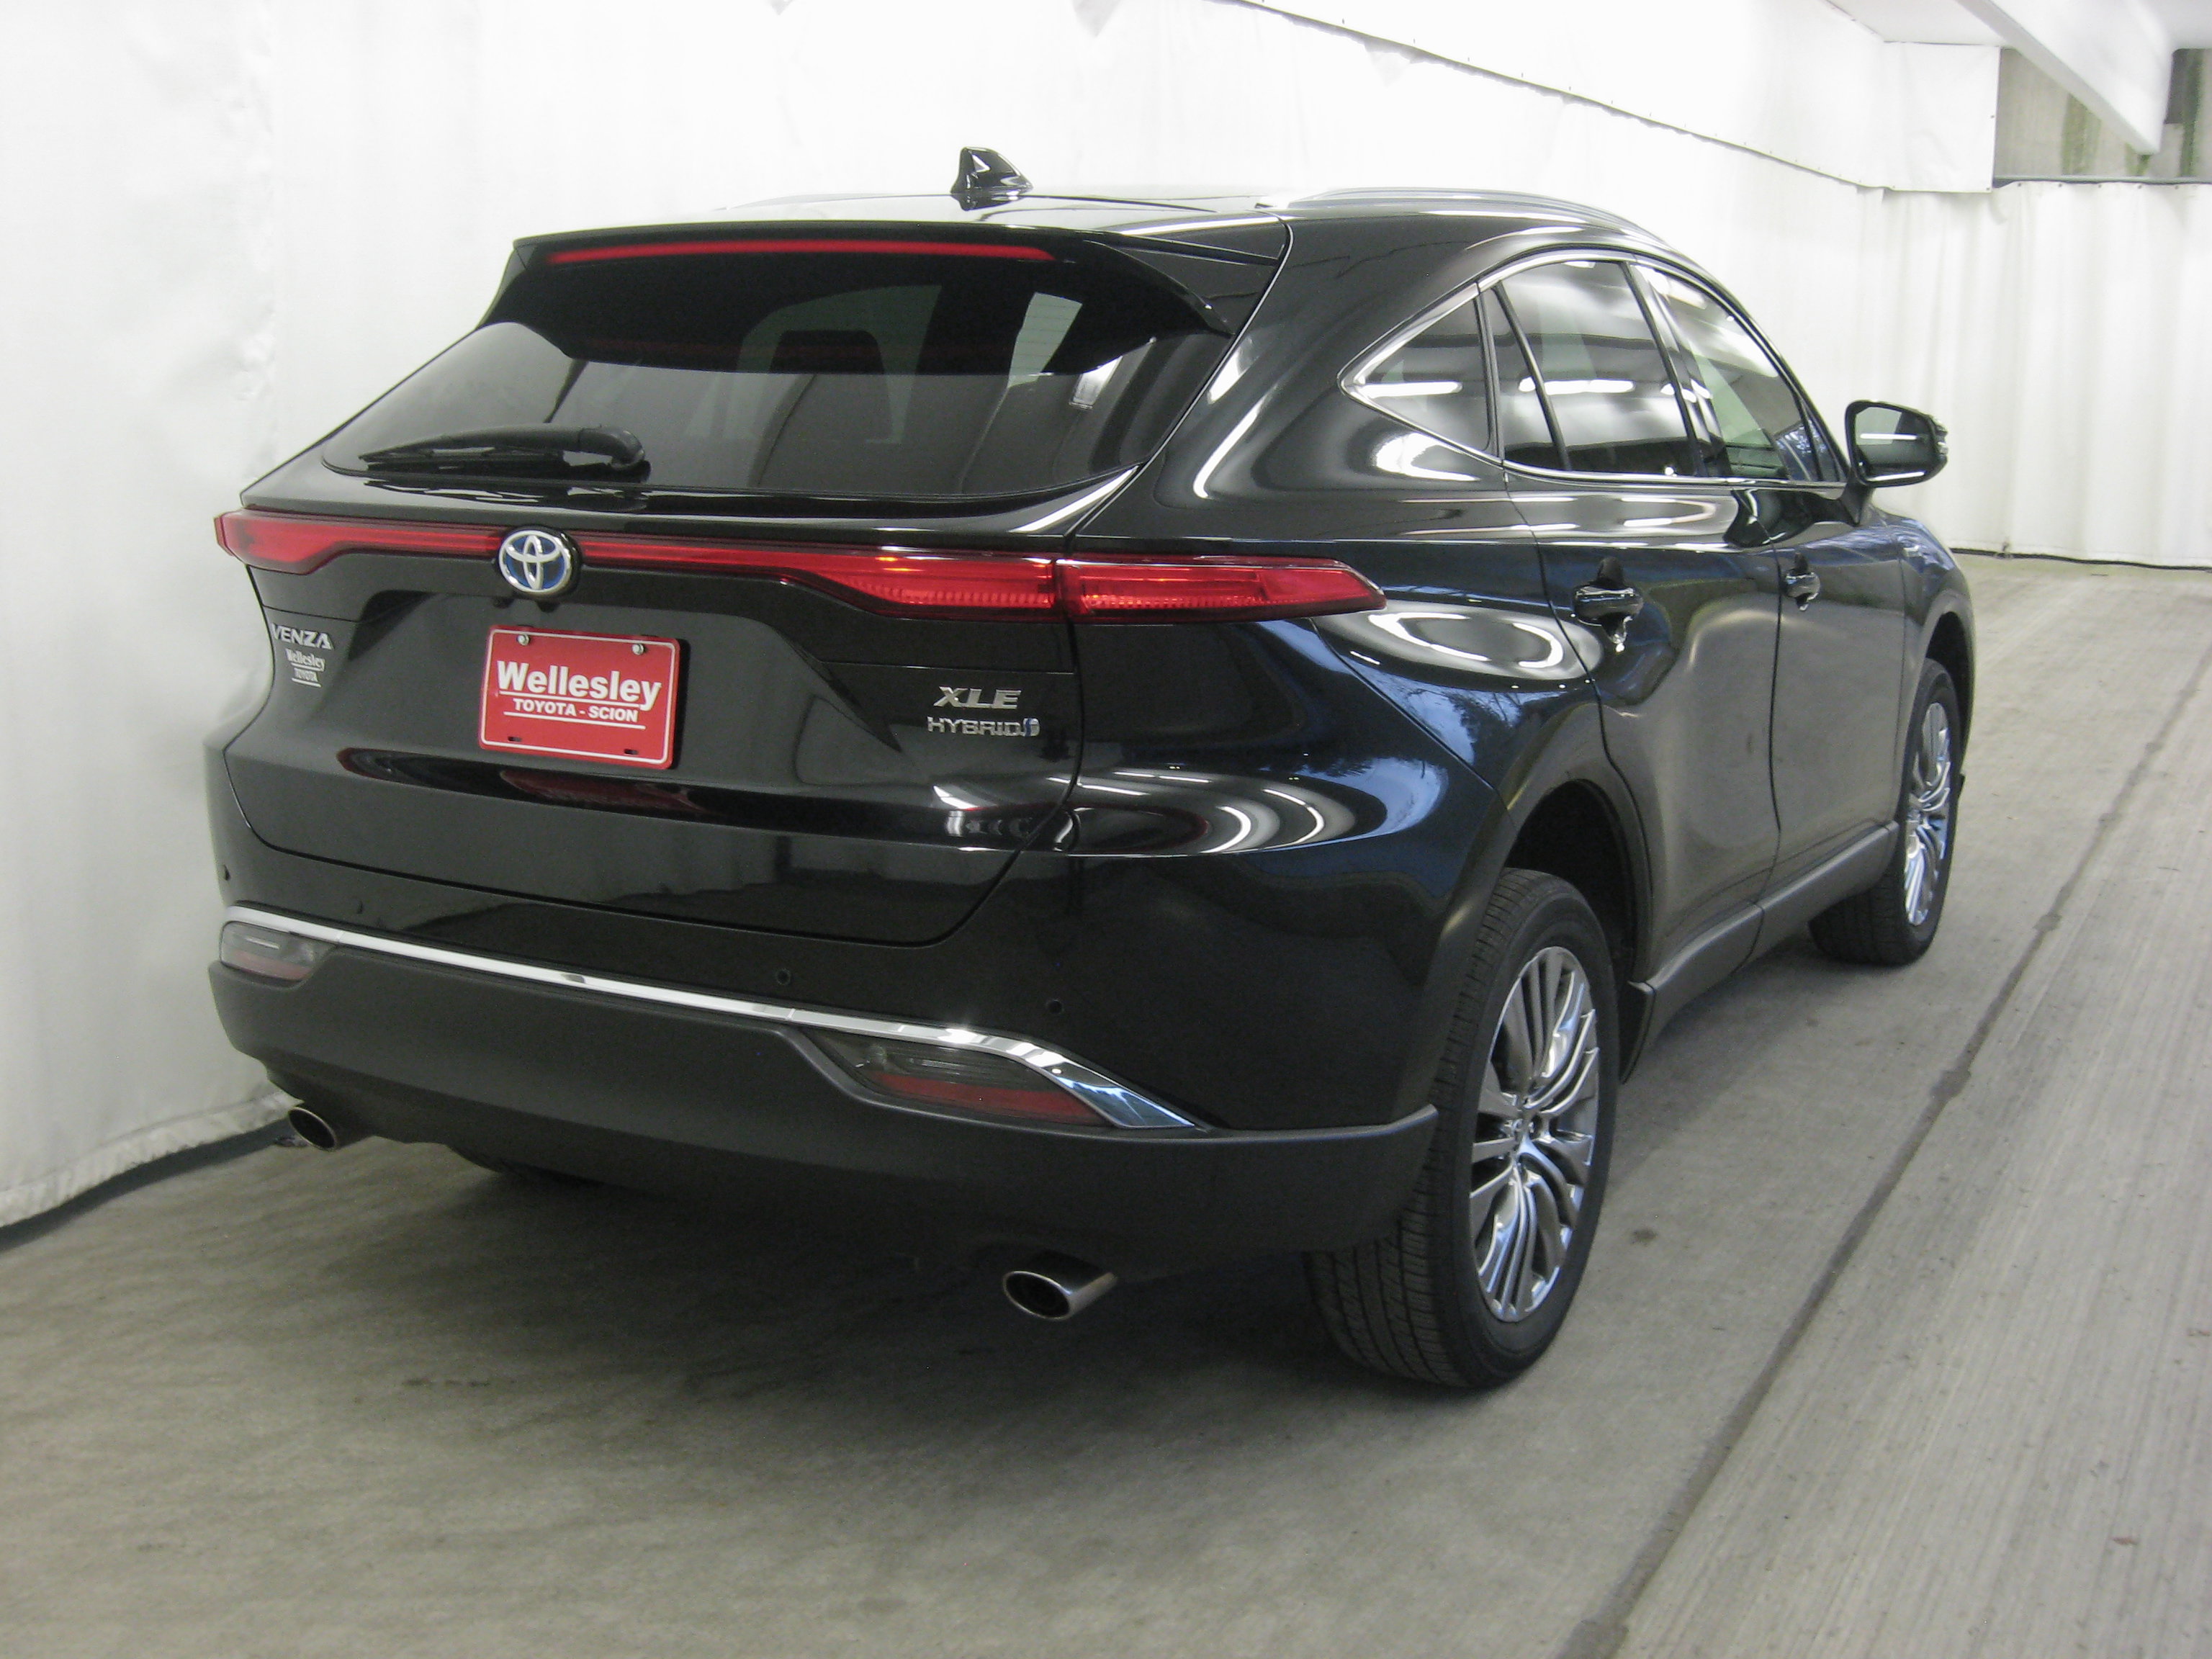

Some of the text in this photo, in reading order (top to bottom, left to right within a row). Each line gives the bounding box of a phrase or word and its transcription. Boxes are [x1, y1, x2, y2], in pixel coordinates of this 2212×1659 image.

[270, 623, 334, 650] VENZA
[497, 660, 662, 711] Wellesley
[933, 685, 1021, 709] XLE
[513, 698, 576, 716] TOYOTA
[588, 706, 639, 723] SCION
[927, 716, 1021, 736] HYBRID
